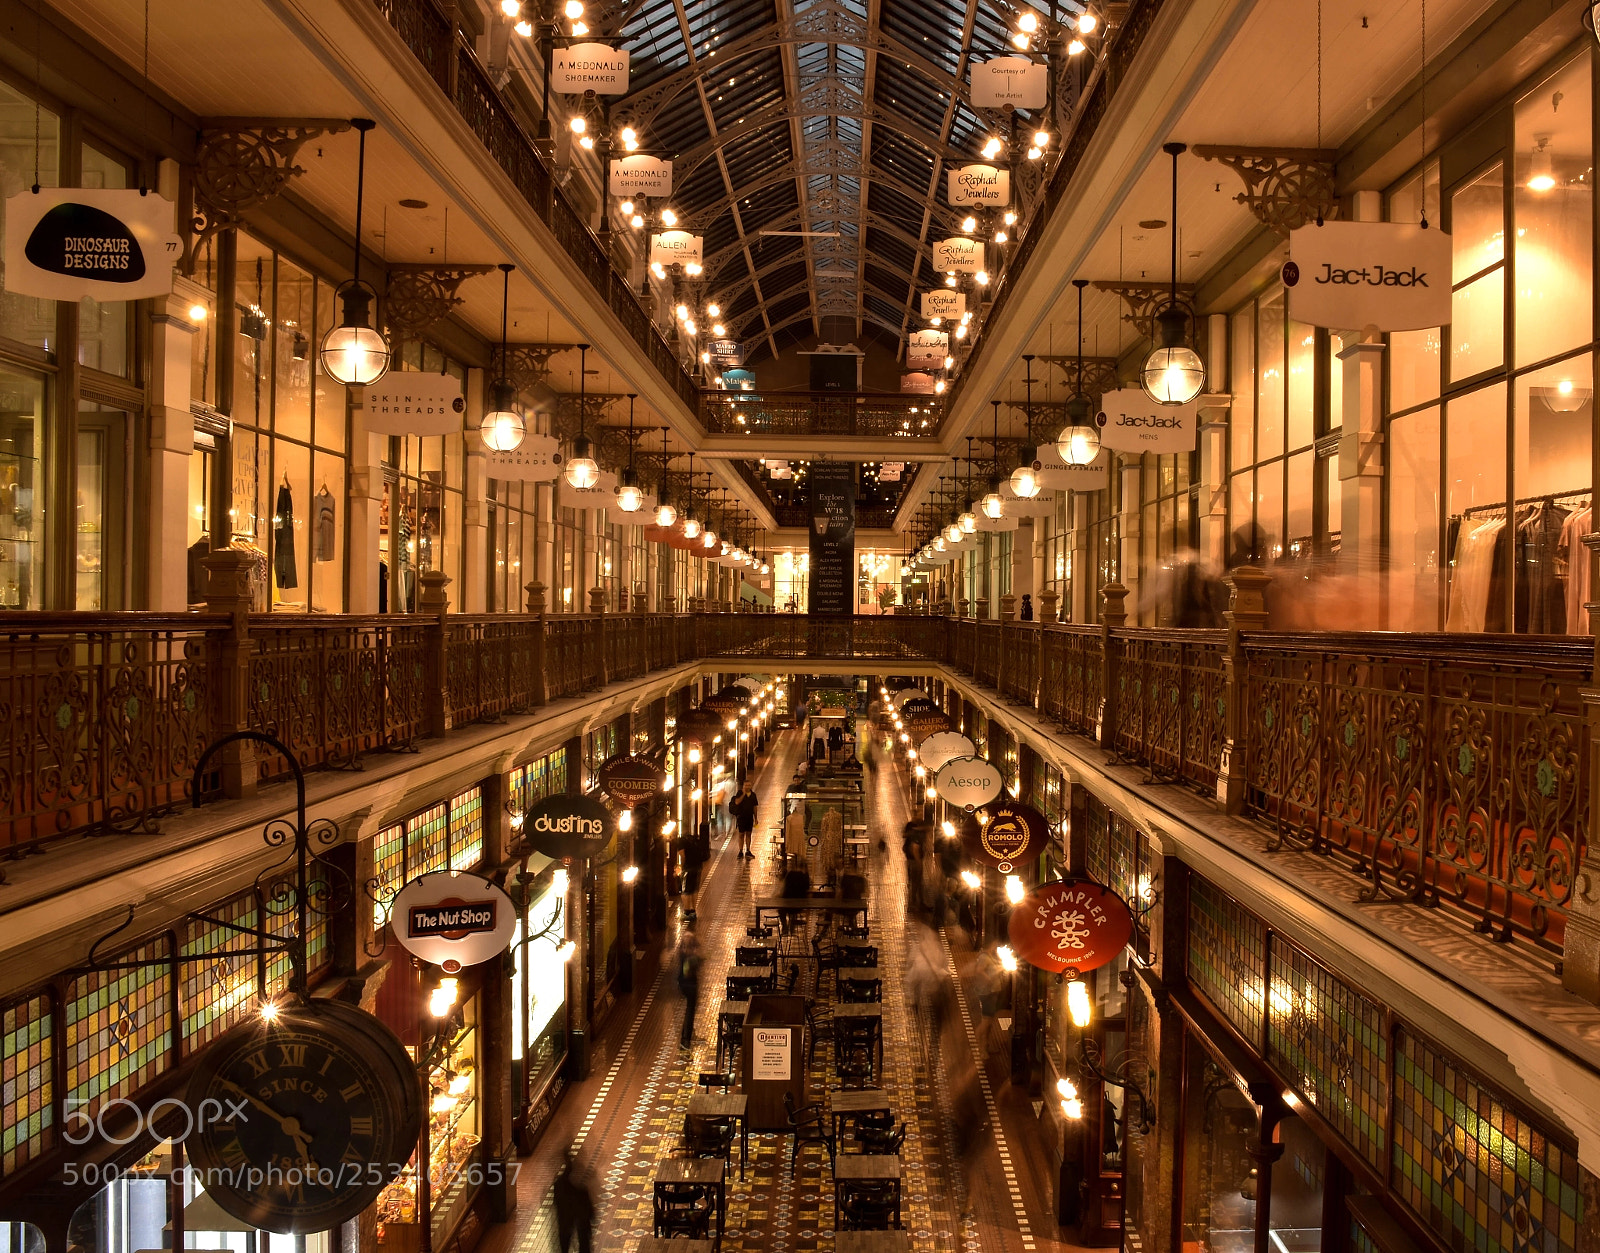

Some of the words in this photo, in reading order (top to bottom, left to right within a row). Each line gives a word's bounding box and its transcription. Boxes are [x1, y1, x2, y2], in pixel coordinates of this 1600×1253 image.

[559, 61, 564, 70] A
[565, 74, 616, 83] SHOEMAKER
[620, 180, 662, 188] SHOEMAKER
[958, 173, 998, 189] Raphael
[956, 187, 1000, 202] Jewellers
[64, 237, 130, 253] DINOSAUR
[165, 242, 177, 252] 77
[656, 241, 687, 249] ALLEN
[64, 254, 130, 270] DESIGNS
[1285, 268, 1296, 279] 76
[1315, 263, 1429, 288] Jac+Jack
[371, 395, 412, 403] SKIN
[371, 405, 445, 414] THREADS
[1116, 413, 1182, 429] Jac+Jack
[819, 493, 845, 501] Explore
[912, 717, 945, 725] GALLERY
[911, 723, 950, 732] SHOPPING
[608, 780, 657, 790] COOMBS
[628, 790, 654, 801] REPAIRS
[534, 813, 603, 834] dustins
[1034, 891, 1107, 929] CRUMPLER
[415, 913, 437, 928] The
[438, 911, 460, 926] Nut
[460, 909, 491, 925] Shop
[1046, 951, 1082, 964] MELBOURNE
[1065, 969, 1076, 978] 26
[258, 1077, 329, 1104] SINCE
